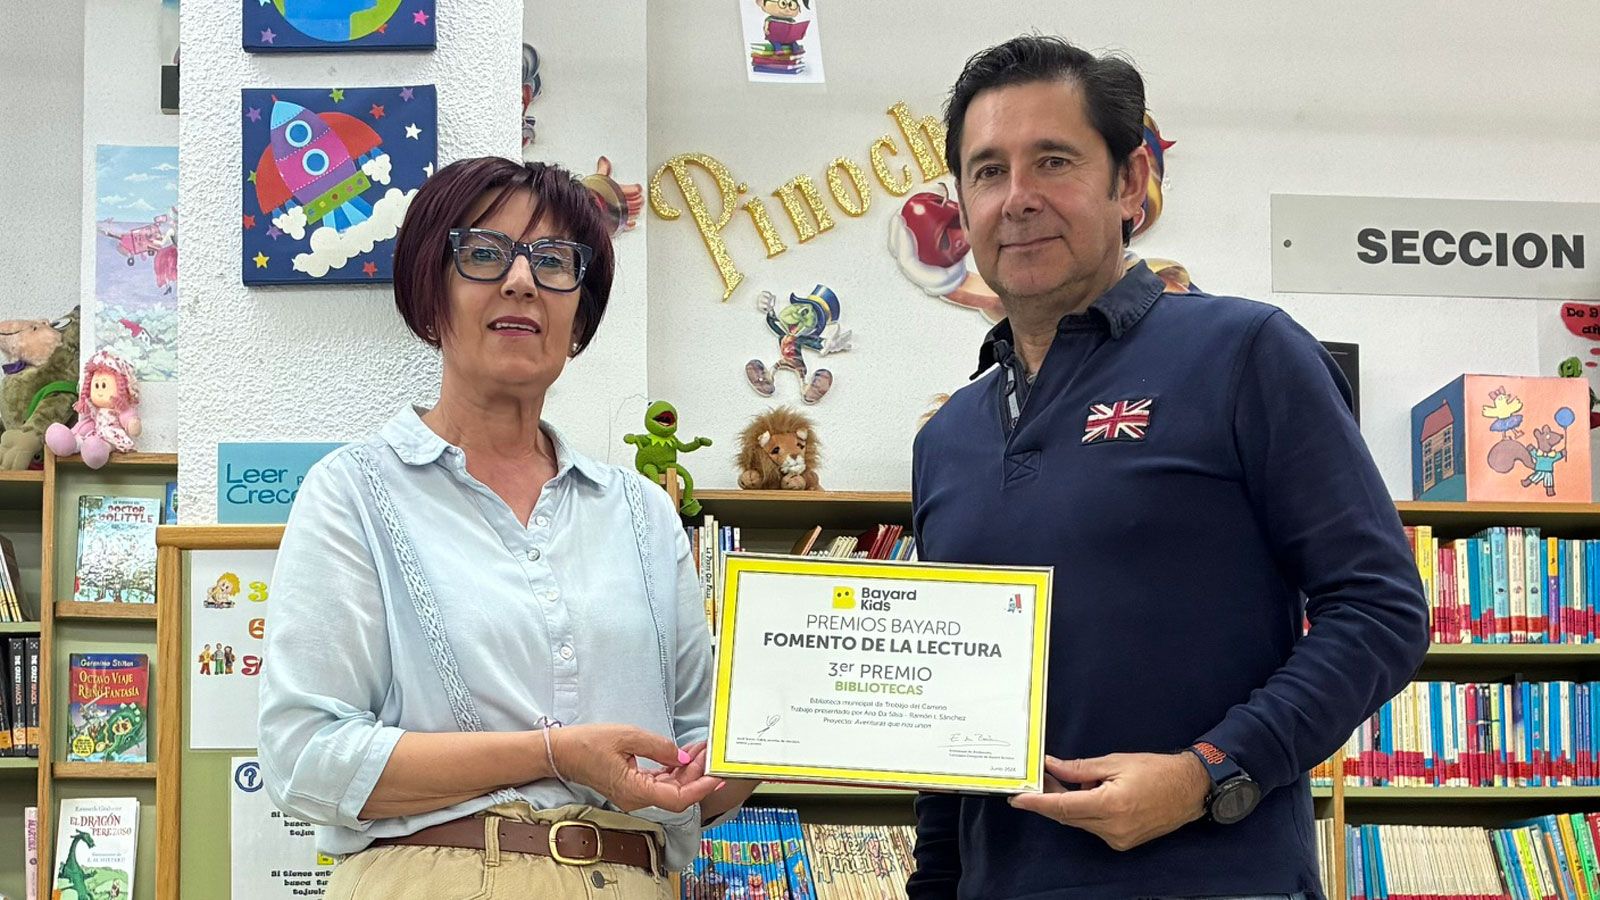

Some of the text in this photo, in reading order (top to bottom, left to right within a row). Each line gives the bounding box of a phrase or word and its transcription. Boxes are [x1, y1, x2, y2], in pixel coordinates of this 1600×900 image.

[1356, 227, 1585, 269] SECCION
[1566, 307, 1585, 317] De
[226, 463, 288, 484] Leer
[108, 505, 145, 513] DOCTOR
[247, 581, 268, 602] 3
[861, 587, 917, 601] Bayard
[860, 600, 891, 611] Kids
[248, 618, 265, 639] 6
[807, 615, 961, 636] PREMIOS BAYARD
[763, 632, 1002, 657] FOMENTO DE LA LECTURA
[81, 659, 110, 667] Geronimo
[241, 655, 263, 676] 9
[860, 665, 932, 681] PREMIO
[835, 681, 924, 695] BIBLIOTECAS
[842, 700, 873, 708] municipal
[921, 703, 947, 711] Camino
[814, 708, 850, 716] presentado
[939, 713, 966, 721] Sánchez
[855, 719, 886, 727] Aventuras
[69, 813, 121, 827] EL DRAGÓN
